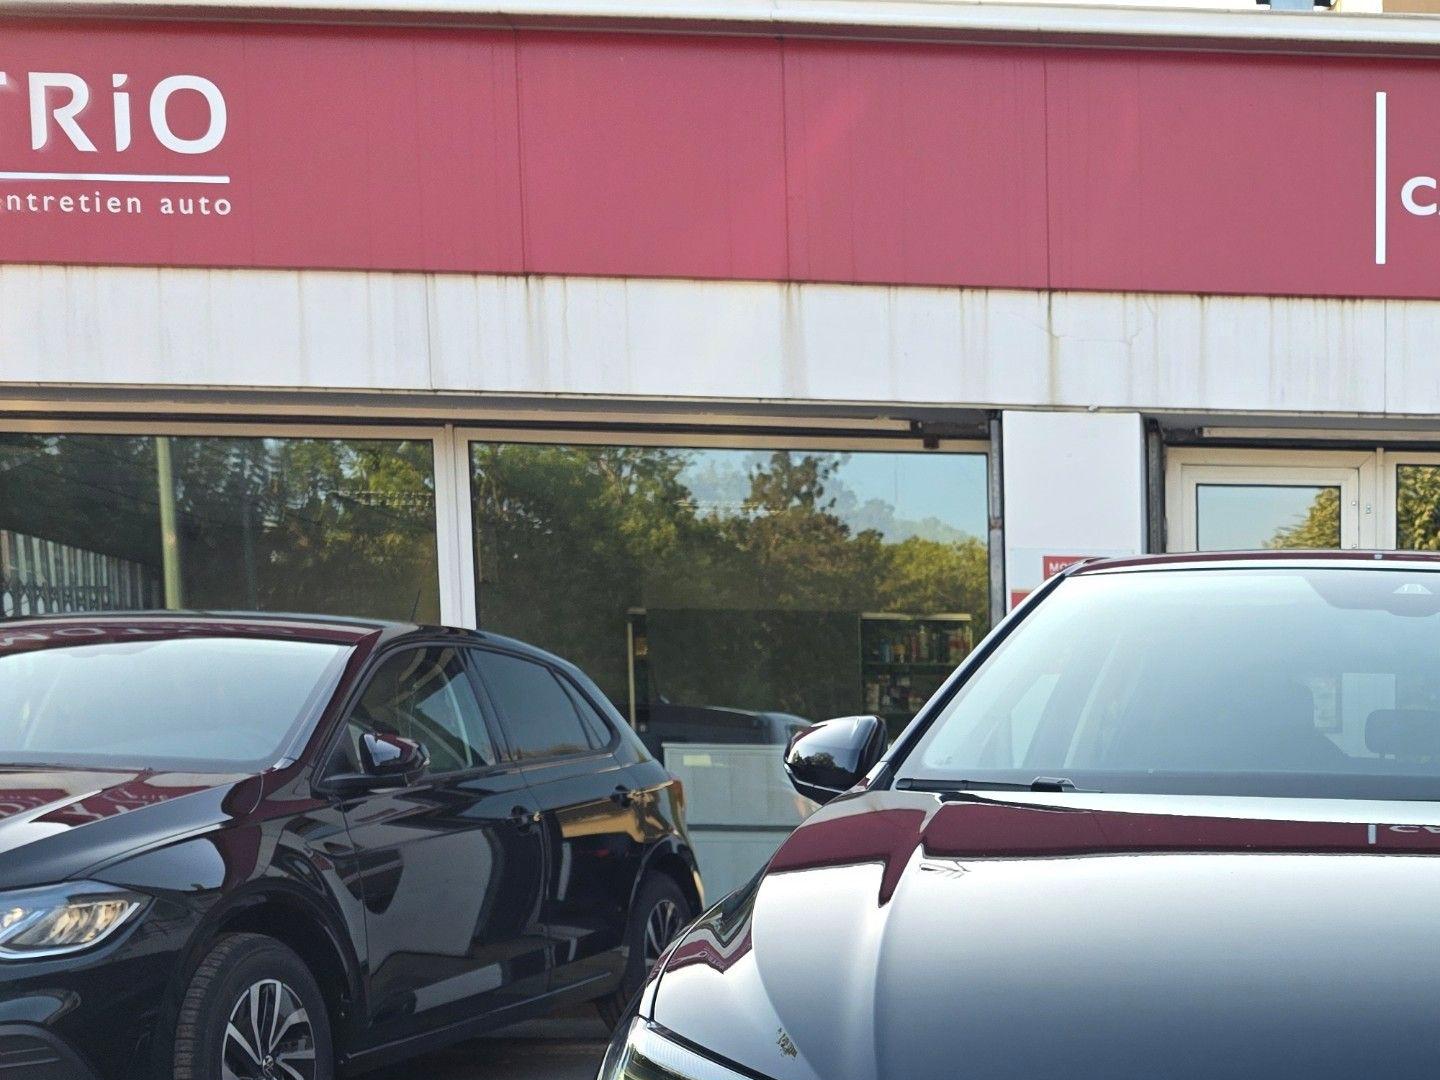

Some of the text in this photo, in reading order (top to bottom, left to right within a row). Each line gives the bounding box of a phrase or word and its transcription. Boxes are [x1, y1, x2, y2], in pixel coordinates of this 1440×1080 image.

[0, 71, 227, 154] RiO
[0, 191, 232, 215] ntretien auto
